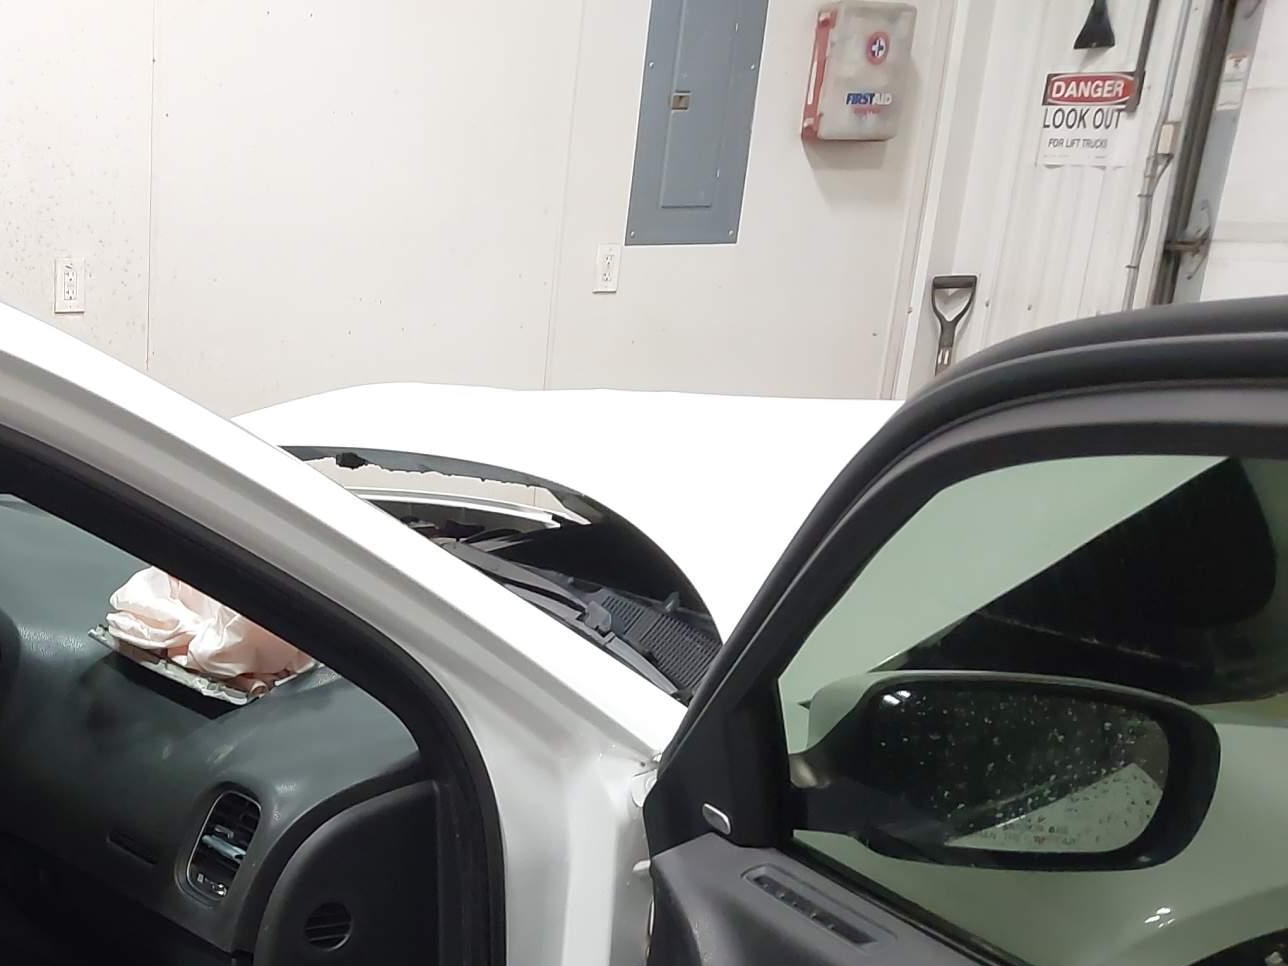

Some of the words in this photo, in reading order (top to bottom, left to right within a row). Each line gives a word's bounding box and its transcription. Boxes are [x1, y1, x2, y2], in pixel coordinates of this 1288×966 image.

[1052, 80, 1124, 98] DANGER
[1043, 107, 1089, 129] LOOK
[1093, 107, 1121, 129] OUT
